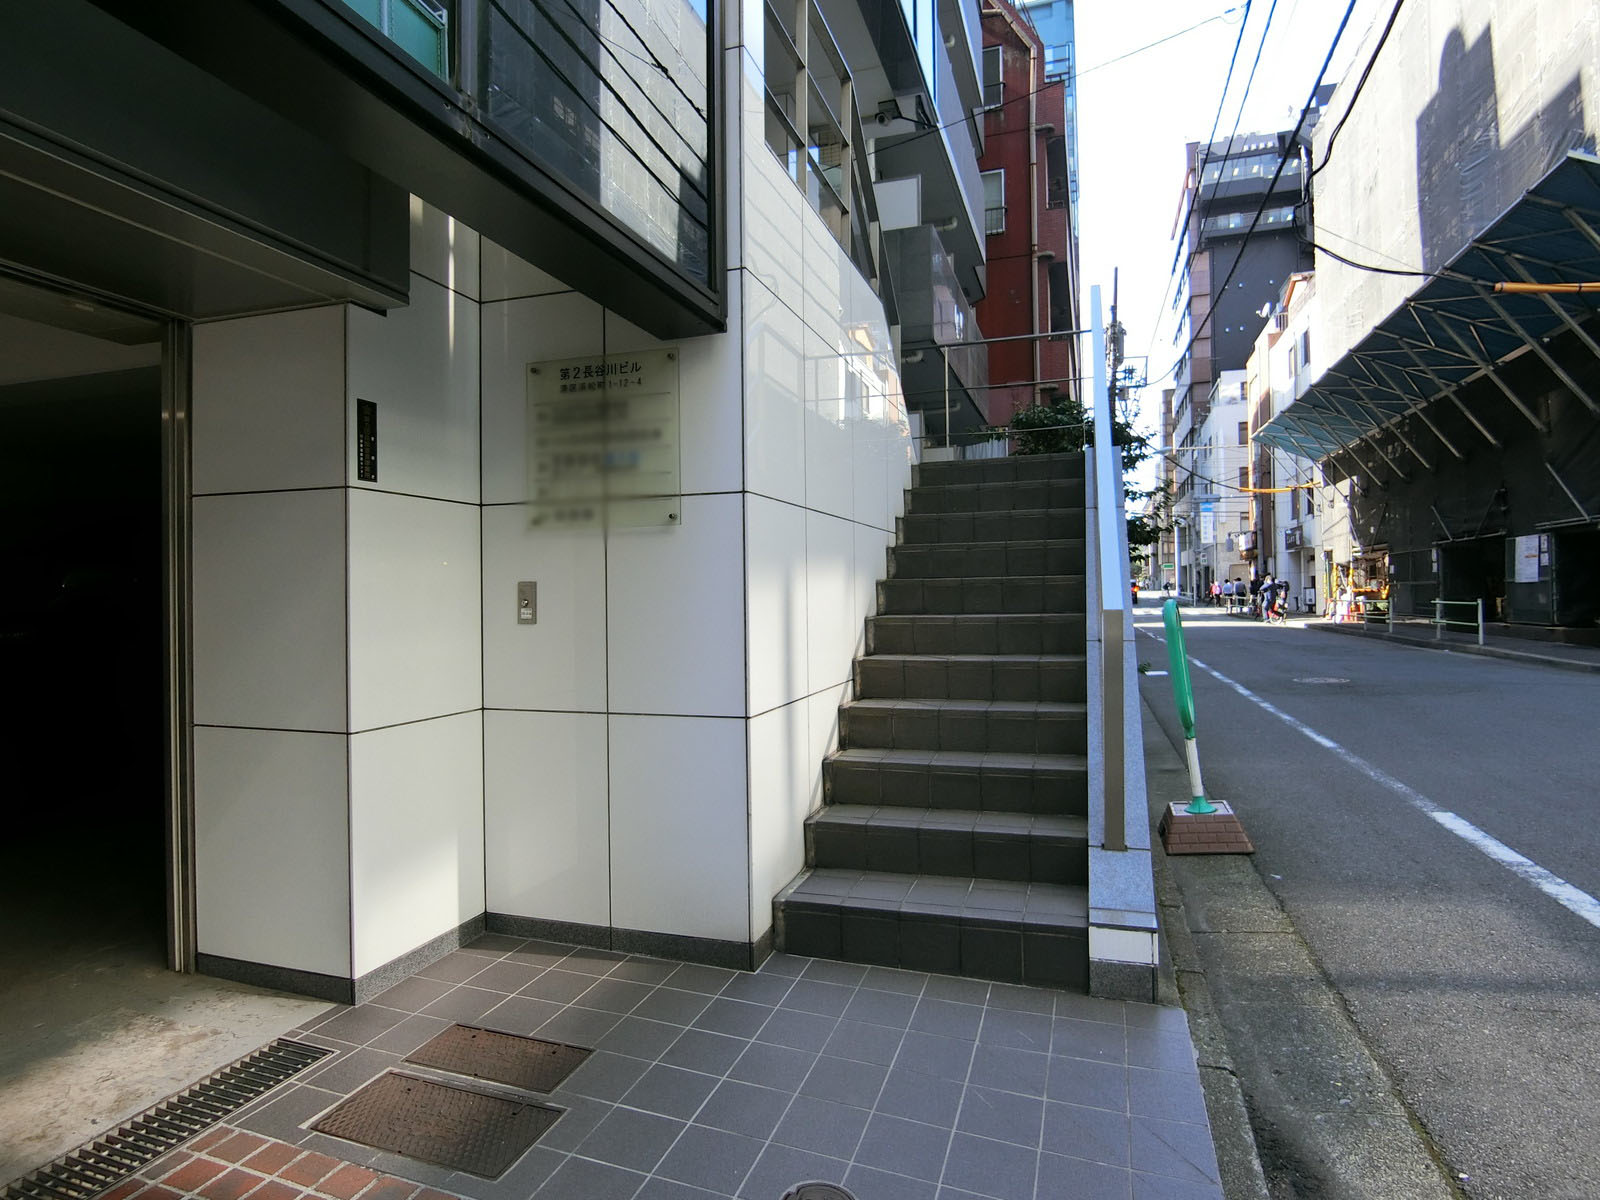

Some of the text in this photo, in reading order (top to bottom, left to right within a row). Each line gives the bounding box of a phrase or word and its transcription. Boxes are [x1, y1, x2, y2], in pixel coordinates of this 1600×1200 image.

[559, 361, 643, 381] 第2長谷川ビル
